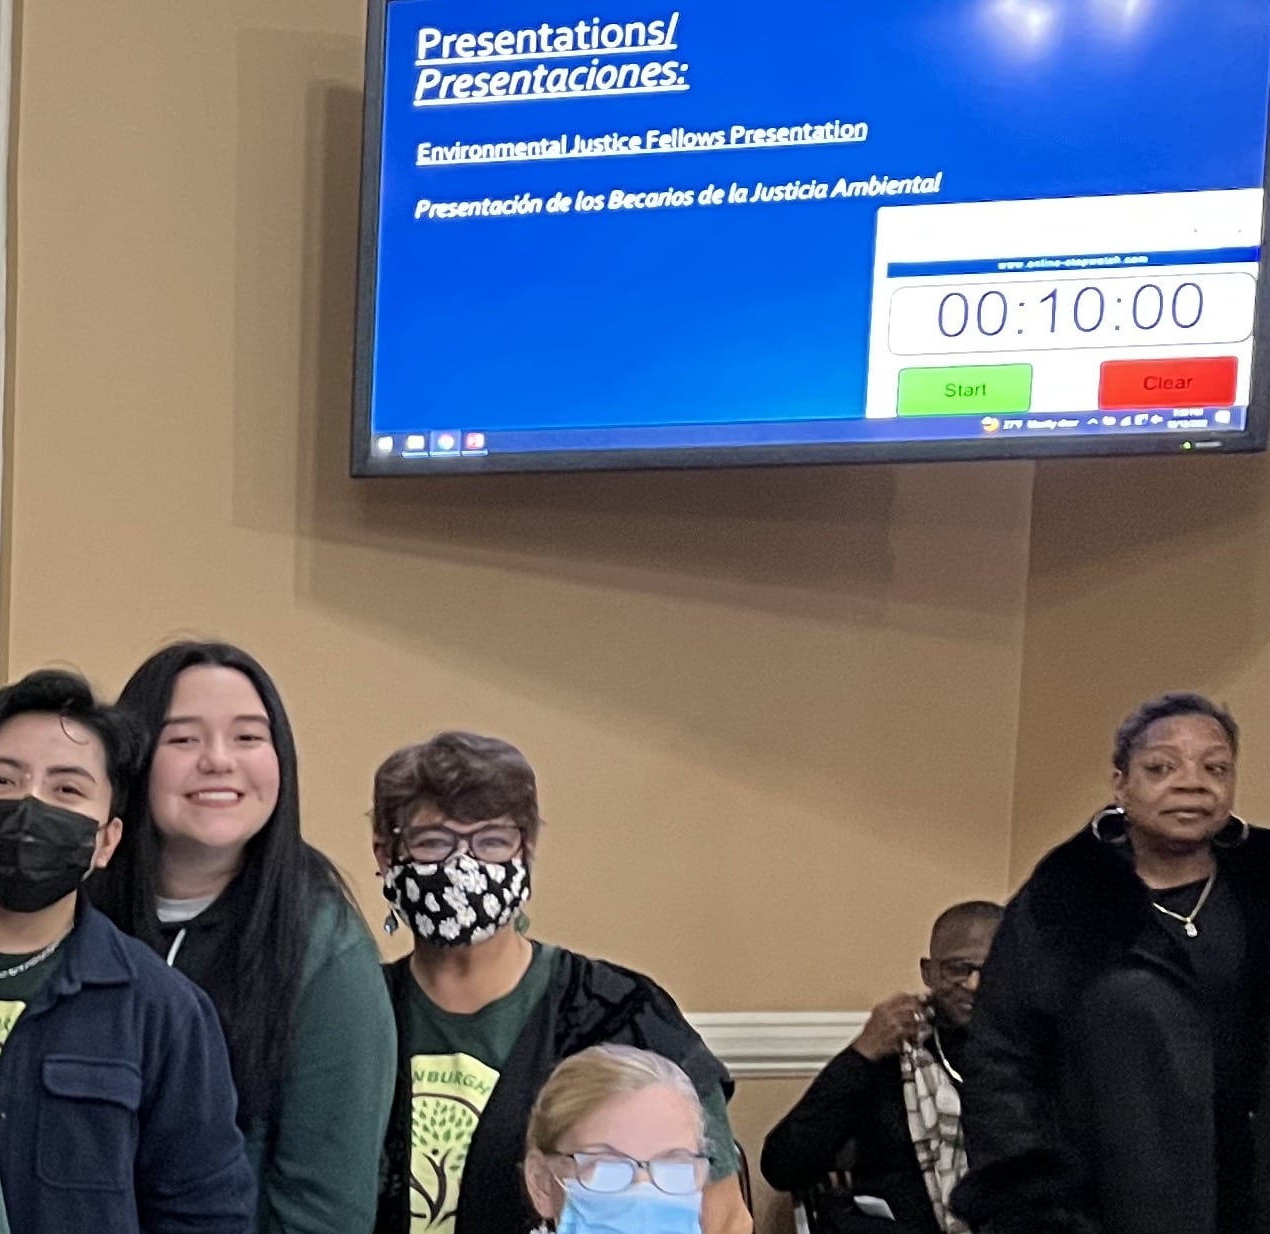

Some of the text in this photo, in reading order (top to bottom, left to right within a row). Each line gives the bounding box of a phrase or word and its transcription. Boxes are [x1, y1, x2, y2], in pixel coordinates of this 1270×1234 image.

[416, 12, 680, 62] Presentations/
[414, 59, 690, 102] Presentaciones:
[416, 121, 868, 164] Environmental Justice Fellows Presentation
[415, 171, 943, 219] Presentación de los Becarios de la Justicia Ambiental
[938, 282, 1204, 338] 00:10:00
[944, 383, 987, 399] Start
[1142, 375, 1194, 392] Clear
